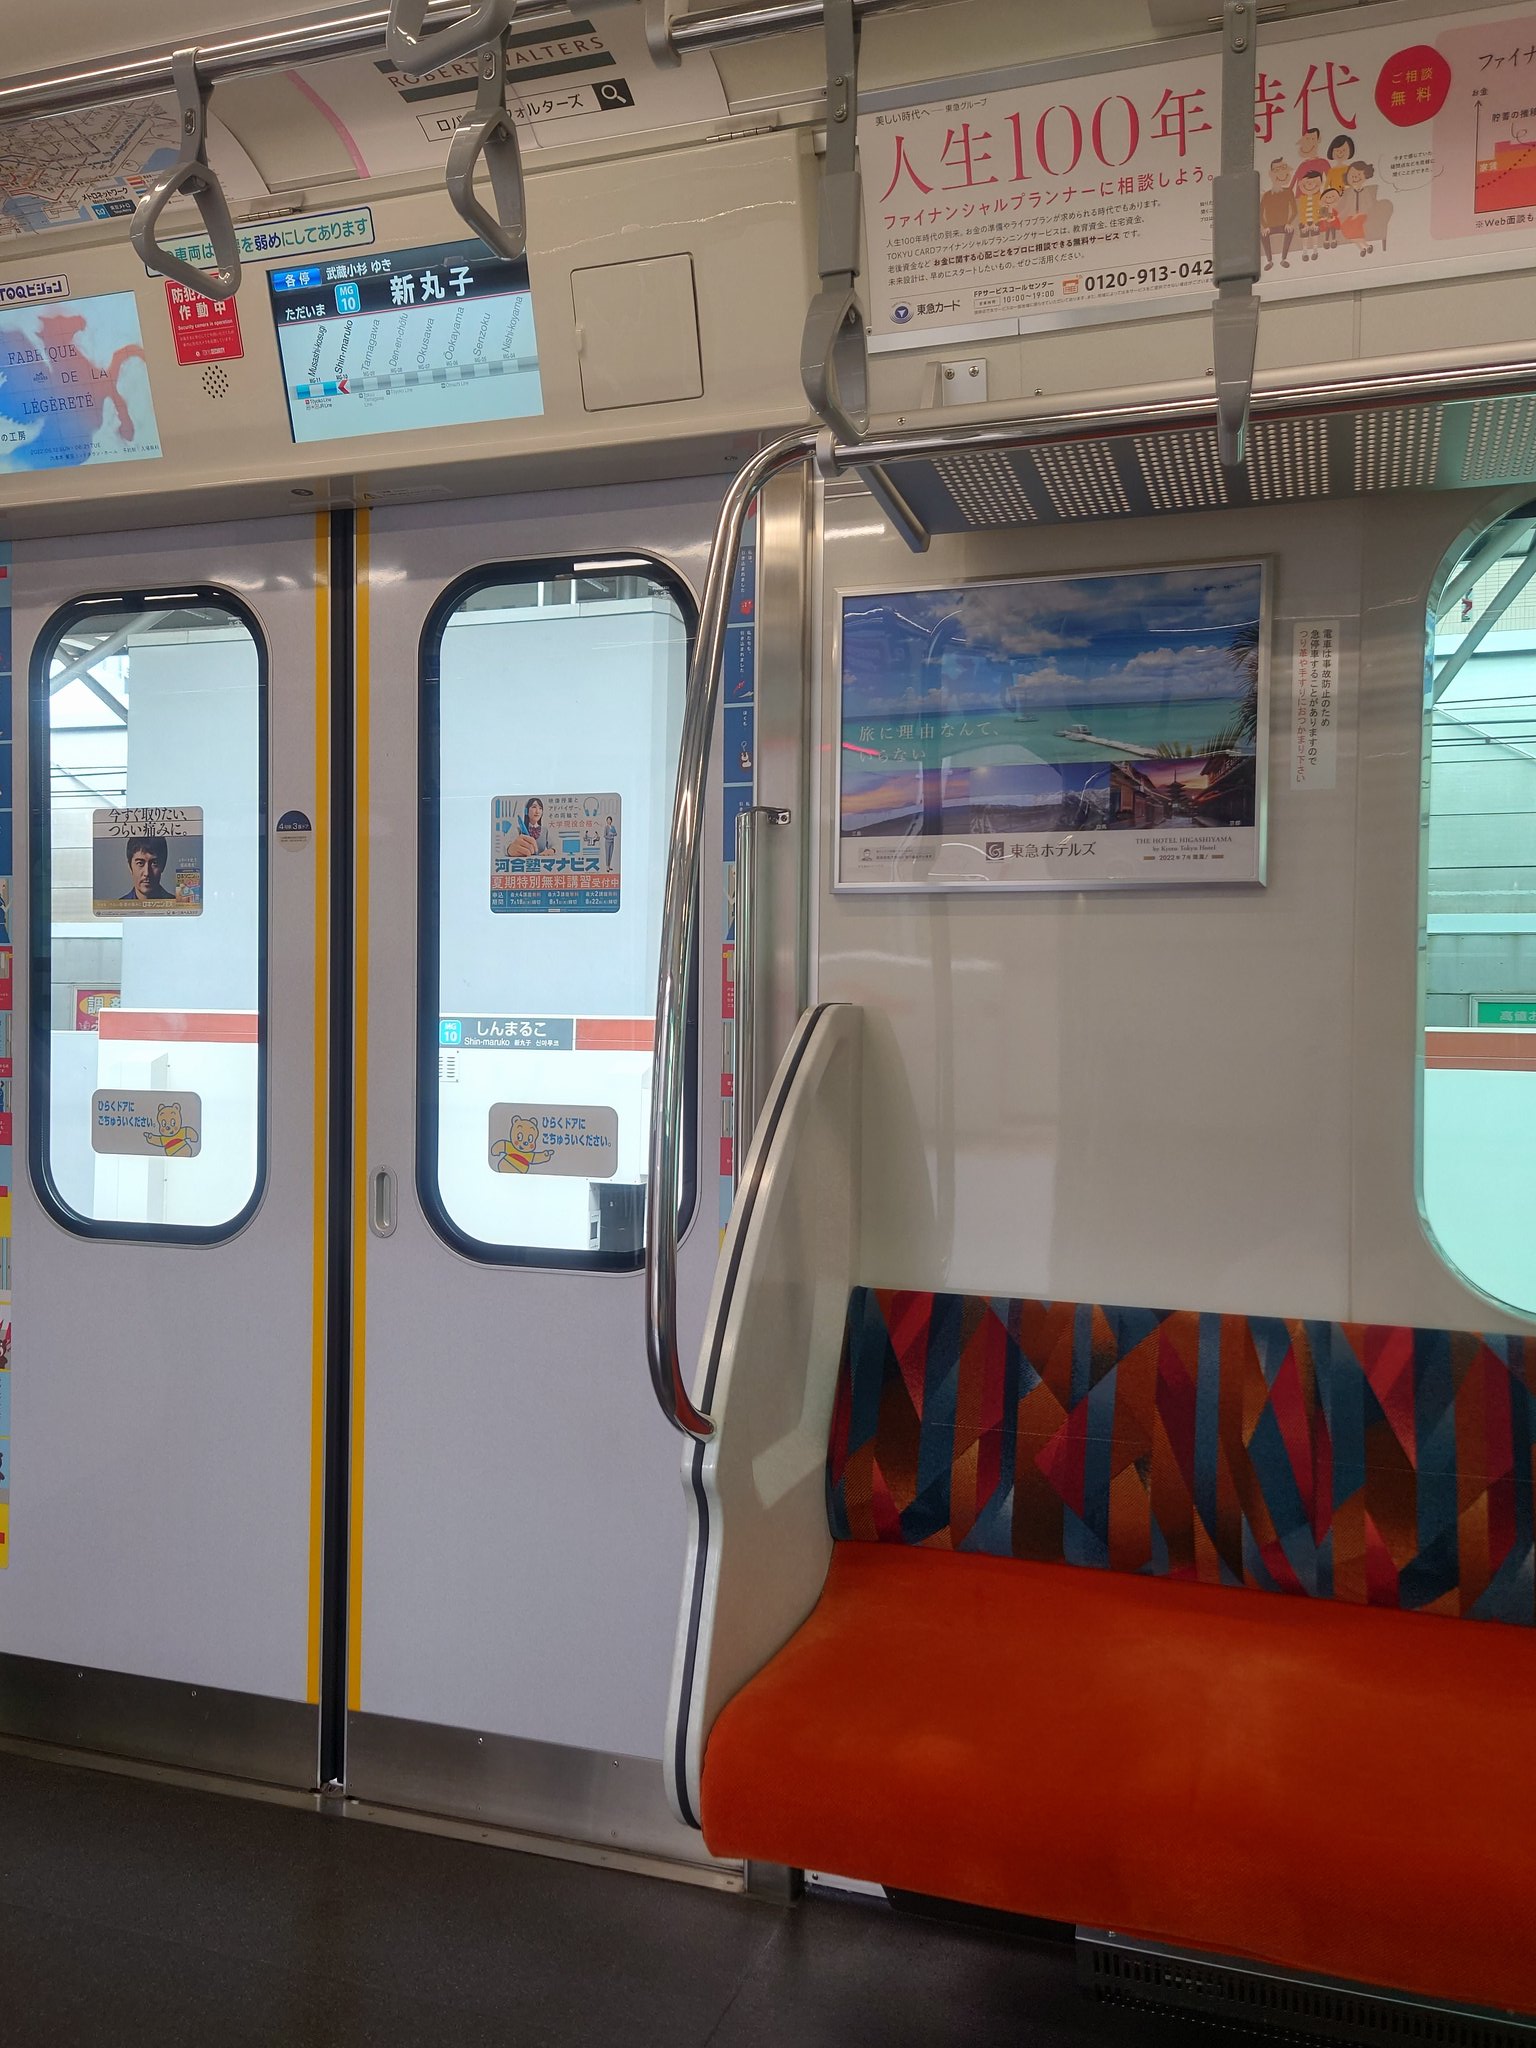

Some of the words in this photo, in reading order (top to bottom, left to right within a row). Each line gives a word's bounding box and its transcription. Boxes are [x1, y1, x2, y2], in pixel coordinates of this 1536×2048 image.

[1391, 67, 1433, 84] ご相談
[1391, 86, 1432, 106] 無料
[875, 108, 930, 126] 美しい時代へ
[945, 98, 987, 112] 東急グループ
[884, 166, 1213, 230] ファイナンシャルプランナーに相談しよう。
[887, 250, 913, 260] TOKYU
[326, 262, 368, 281] 武蔵小杉
[370, 258, 392, 273] ゆき
[1084, 259, 1214, 291] 0120-913-042
[285, 271, 311, 288] 各停
[390, 266, 474, 306] 新丸子
[340, 286, 354, 296] MG
[974, 281, 1054, 297] FPサービスコールセンター
[179, 301, 227, 321] 作動中
[285, 303, 326, 321] ただいま
[341, 297, 356, 311] 10
[917, 299, 960, 316] 東急カード
[501, 296, 523, 353] Nishi-koyama
[416, 317, 435, 364] Okusawa
[473, 312, 491, 356] Senzoku
[308, 324, 328, 377] Musashi-kosugi
[334, 319, 354, 374] Shin-maruko
[361, 319, 380, 371] Tamagawa
[61, 371, 78, 384] DE
[91, 367, 108, 380] LA
[1321, 629, 1333, 727] 電車は事故防止のため
[1308, 630, 1320, 766] 急停車することがありますので
[859, 721, 999, 742] 旅に理由なんて、
[859, 748, 926, 763] いらない
[109, 807, 187, 823] 今すぐ取りたい、
[109, 822, 187, 837] つらい痛みに。
[1010, 841, 1096, 858] 東急ホテルズ
[495, 857, 600, 873] 河合塾マナビス
[492, 875, 619, 888] 夏期特別無料講習受付中
[445, 1031, 458, 1042] 10
[477, 1020, 547, 1037] しんまるこ
[464, 1037, 510, 1046] Shin-maruko
[97, 1101, 135, 1112] ひらくドアに
[97, 1116, 156, 1128] ごちゅういください。
[542, 1116, 586, 1130] ひらくドアに
[542, 1133, 612, 1148] ごちゅういください。
